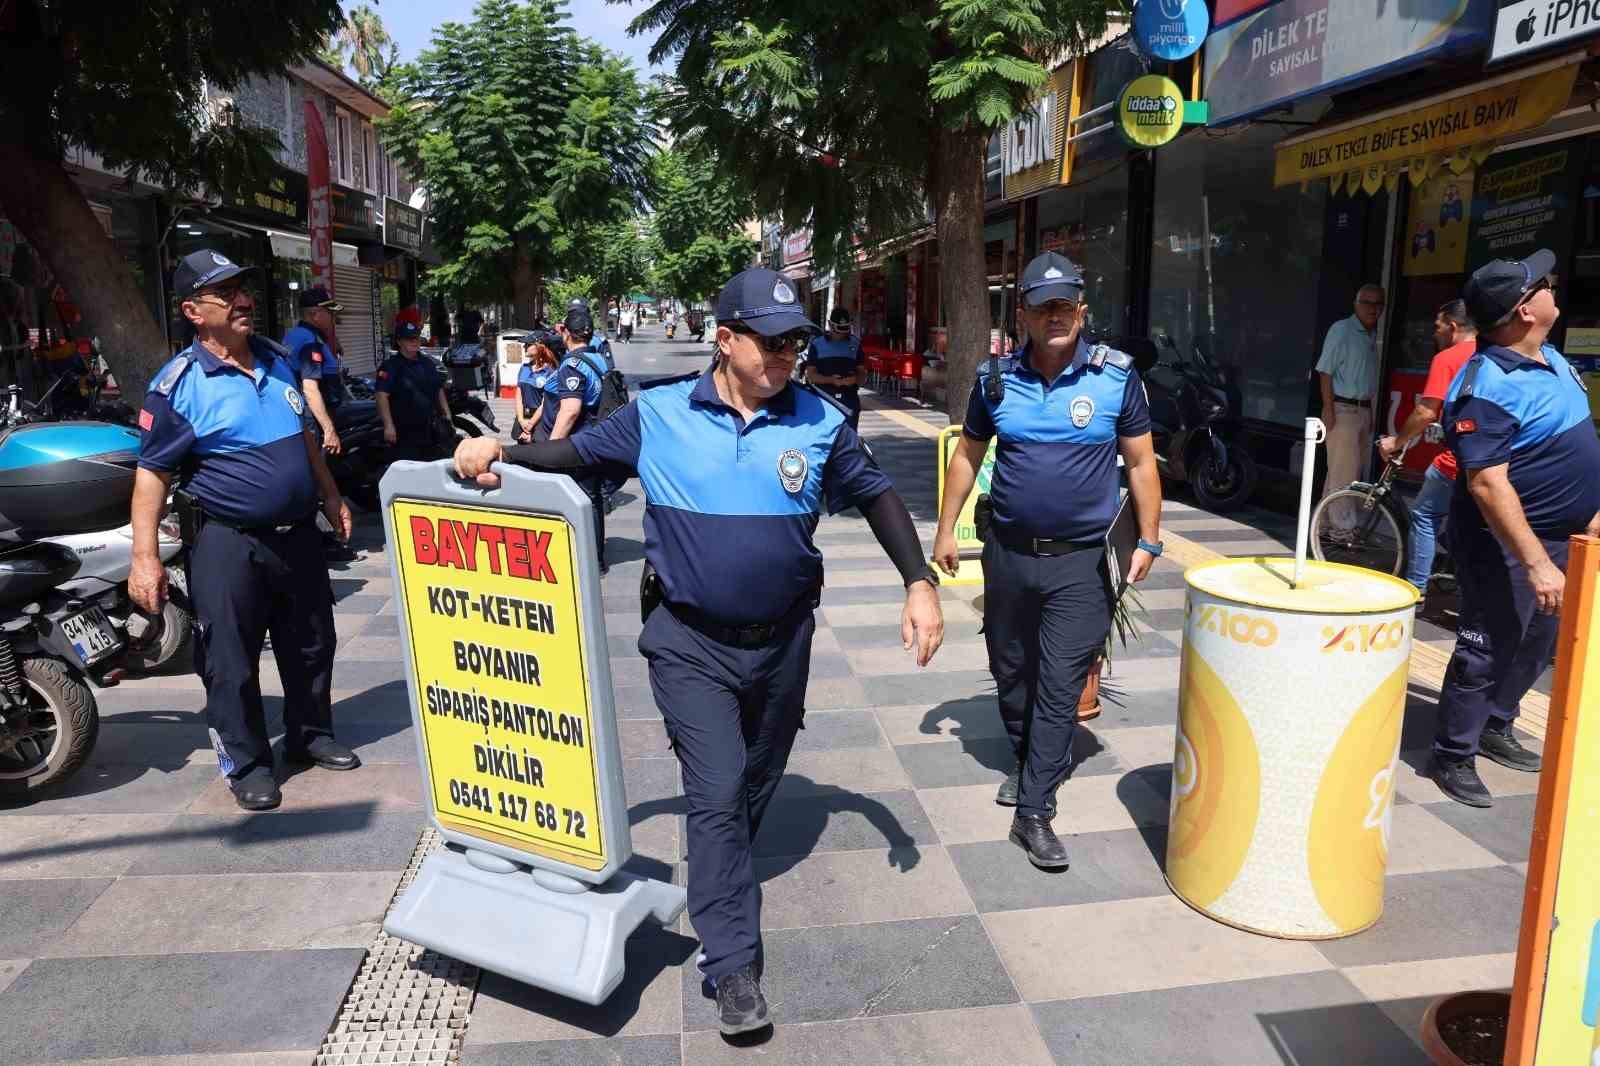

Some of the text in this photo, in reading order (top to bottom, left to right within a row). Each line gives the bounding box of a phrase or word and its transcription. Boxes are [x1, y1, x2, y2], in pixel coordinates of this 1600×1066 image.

[1149, 33, 1196, 46] piyango
[1251, 17, 1299, 60] DİLEK
[1269, 48, 1318, 77] SAYISAL
[1137, 110, 1173, 125] matik
[1300, 146, 1332, 169] DİLEK
[1335, 140, 1368, 161] TEKEL
[1409, 111, 1470, 143] SAYISAL
[409, 515, 558, 584] BAYTEK
[63, 619, 83, 639] 34
[427, 585, 555, 635] KOT-KETEN
[88, 631, 111, 651] 415
[453, 640, 541, 687] BOYANIR
[426, 680, 584, 748] SİPARİŞ PANTOLON
[474, 739, 545, 788] DİKİLİR
[449, 779, 586, 839] 0541 117 68 72
